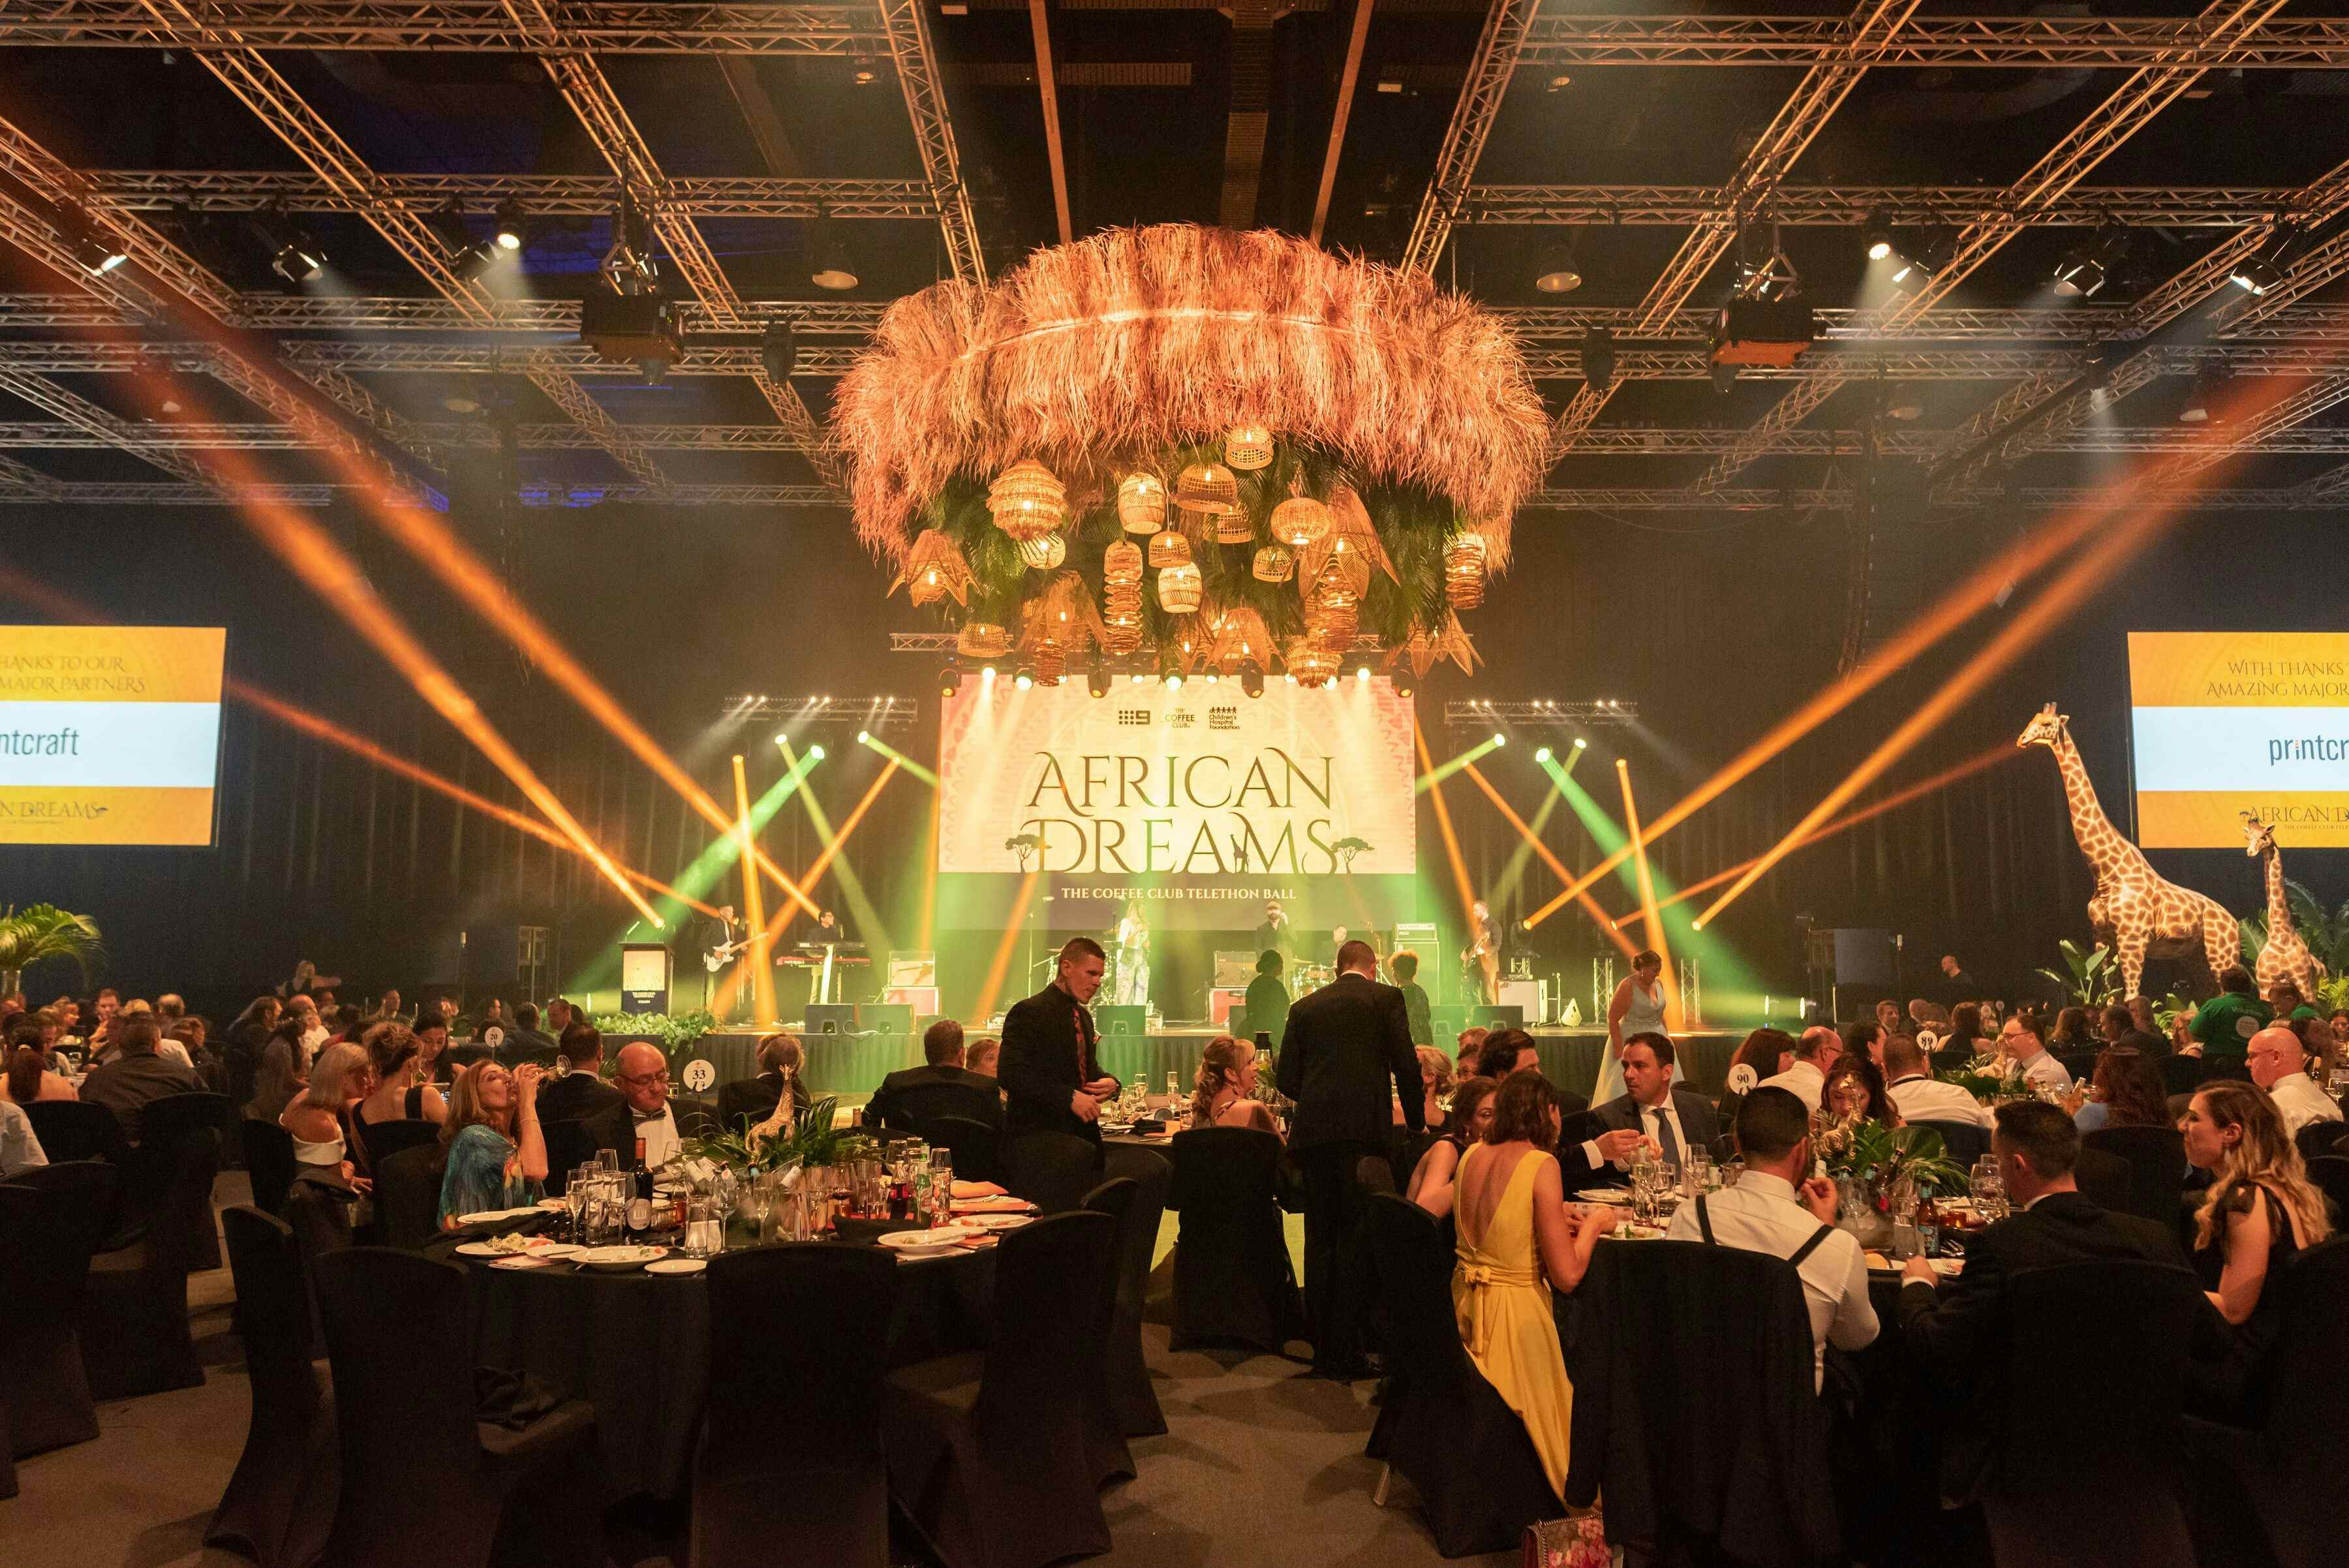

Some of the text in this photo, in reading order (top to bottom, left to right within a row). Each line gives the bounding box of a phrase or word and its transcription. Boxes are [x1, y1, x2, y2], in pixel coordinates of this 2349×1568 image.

[61, 656, 82, 670] TO
[85, 656, 126, 673] OUR
[2228, 658, 2344, 679] WITH THANKS
[61, 677, 146, 694] PARTNERS
[2207, 681, 2349, 699] AMAZING MAJOR
[1025, 747, 1335, 817] AFRICAN
[2250, 805, 2329, 823] AFRICAN
[1020, 812, 1339, 876] DREAMS
[1062, 887, 1296, 899] THE COFFEE CLUB TELETHON BALL
[692, 1069, 705, 1080] 33
[1737, 1073, 1749, 1084] 90
